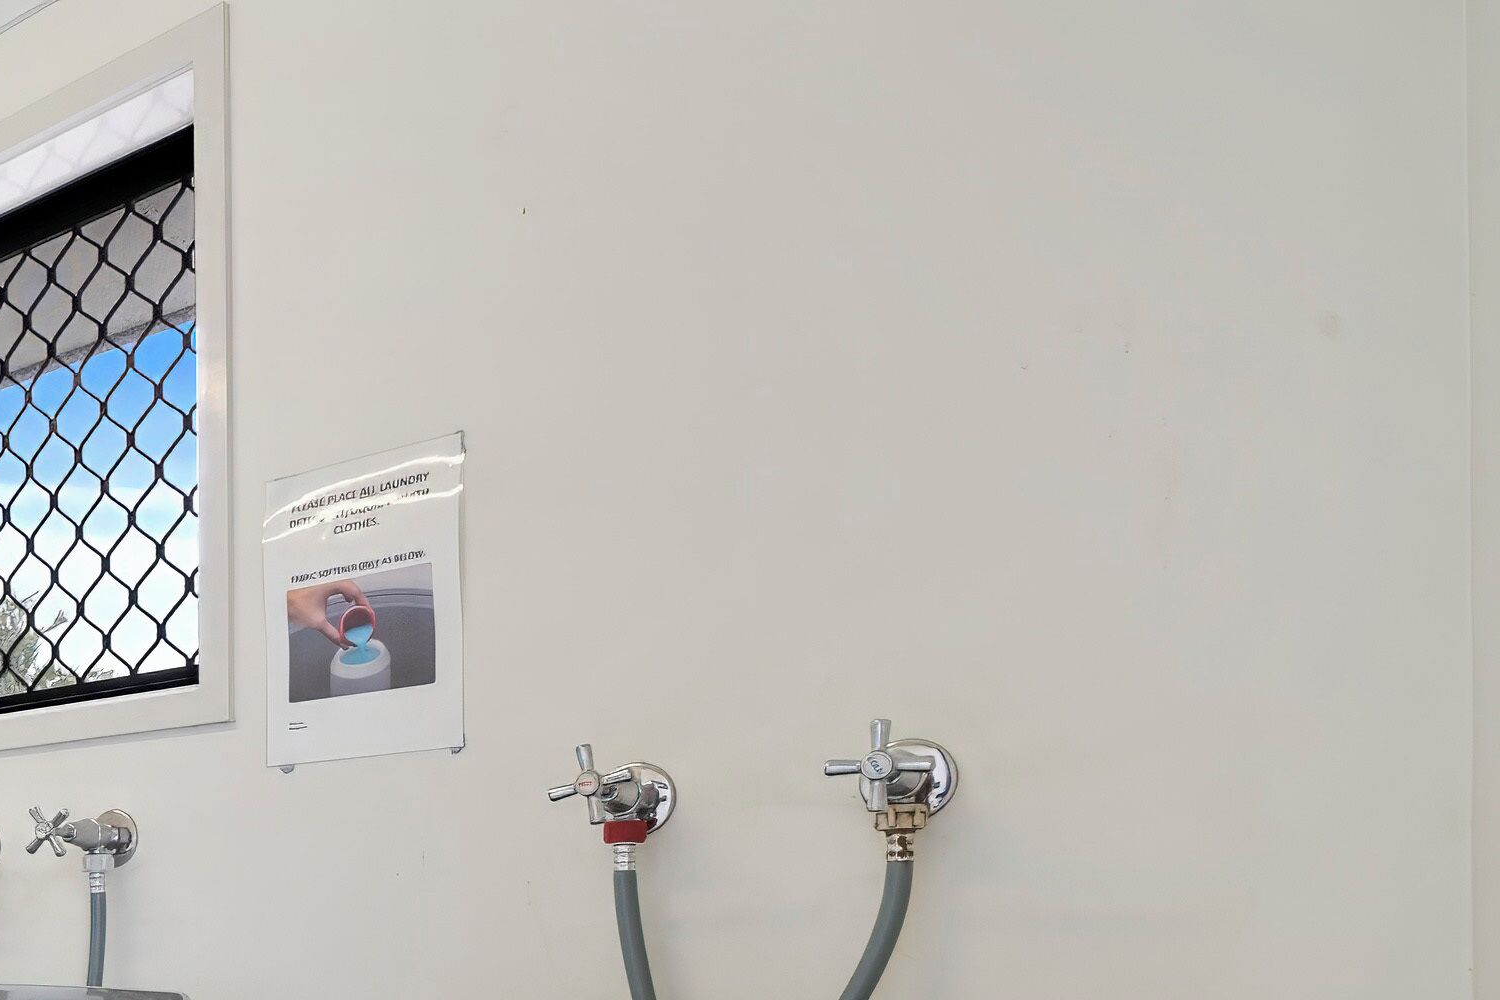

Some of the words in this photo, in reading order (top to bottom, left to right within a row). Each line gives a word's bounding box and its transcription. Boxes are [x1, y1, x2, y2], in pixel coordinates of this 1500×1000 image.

[327, 490, 357, 506] PLACE
[360, 485, 375, 499] ALL
[380, 472, 429, 492] LAUNDRY
[334, 517, 380, 534] CLOTHES.
